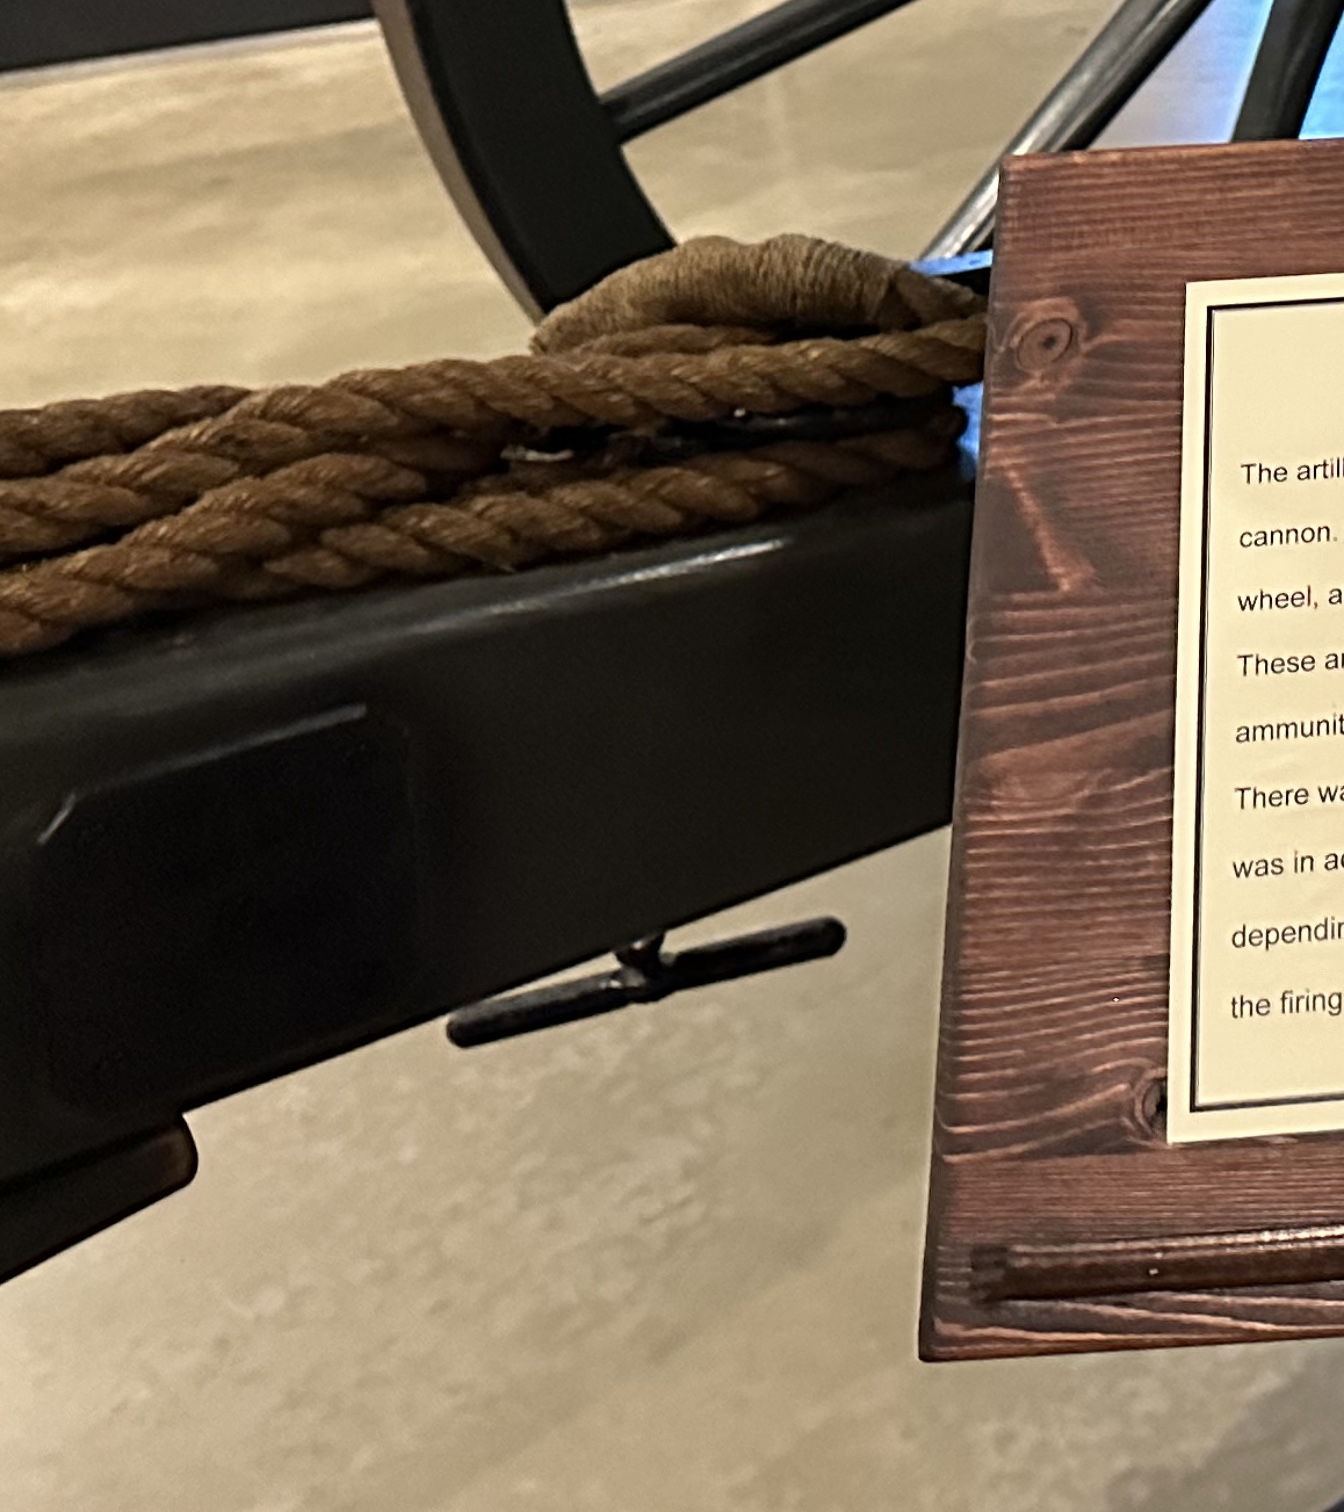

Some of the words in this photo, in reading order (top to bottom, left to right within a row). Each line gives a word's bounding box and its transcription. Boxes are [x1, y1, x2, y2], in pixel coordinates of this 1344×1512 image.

[1239, 462, 1288, 485] The
[1239, 525, 1338, 549] cannon.
[1237, 584, 1319, 612] wheel,
[1236, 653, 1316, 677] These
[1233, 786, 1310, 811] There
[1232, 857, 1285, 879] was
[1293, 849, 1315, 874] in
[1230, 994, 1272, 1020] the
[1279, 988, 1343, 1017] firing
